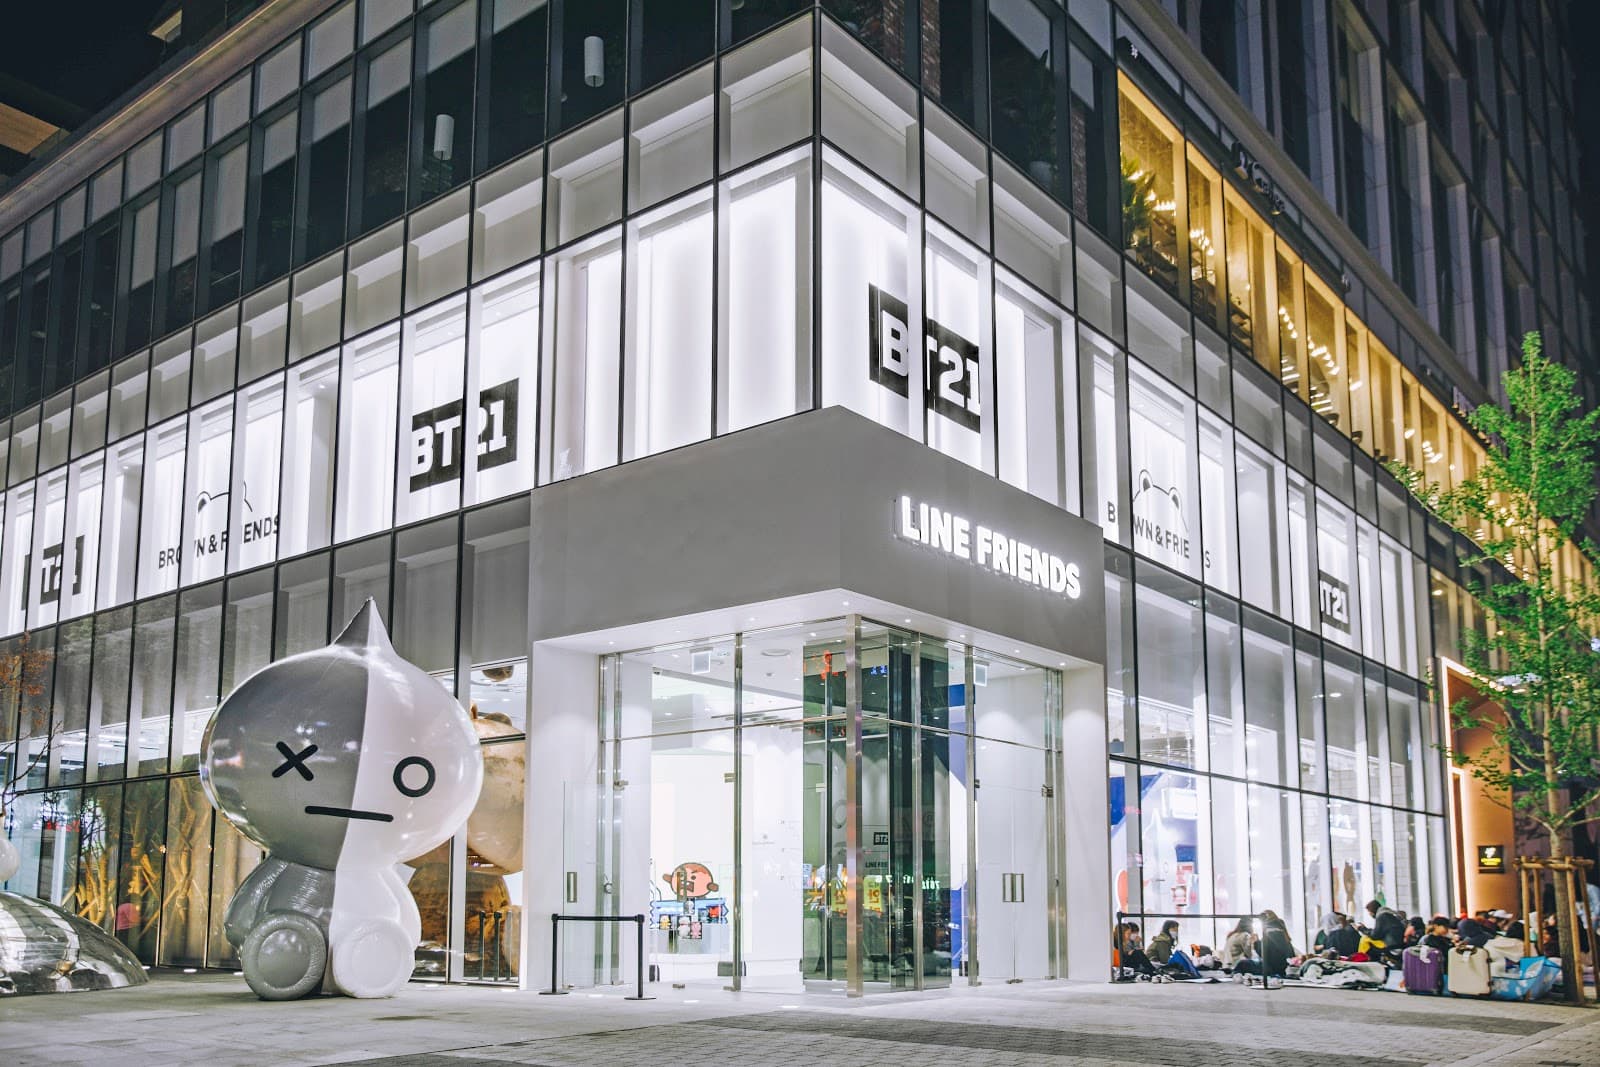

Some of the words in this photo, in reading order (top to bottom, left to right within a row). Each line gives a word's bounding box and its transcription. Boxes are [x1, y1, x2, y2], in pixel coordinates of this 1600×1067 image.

[158, 537, 206, 569] BRN
[209, 534, 219, 554] &
[221, 514, 281, 552] FENDS
[901, 495, 970, 559] LINE
[976, 525, 1082, 600] FRIENDS
[1107, 500, 1153, 542] BWN
[1155, 524, 1164, 547] &
[1165, 530, 1211, 568] FRIES
